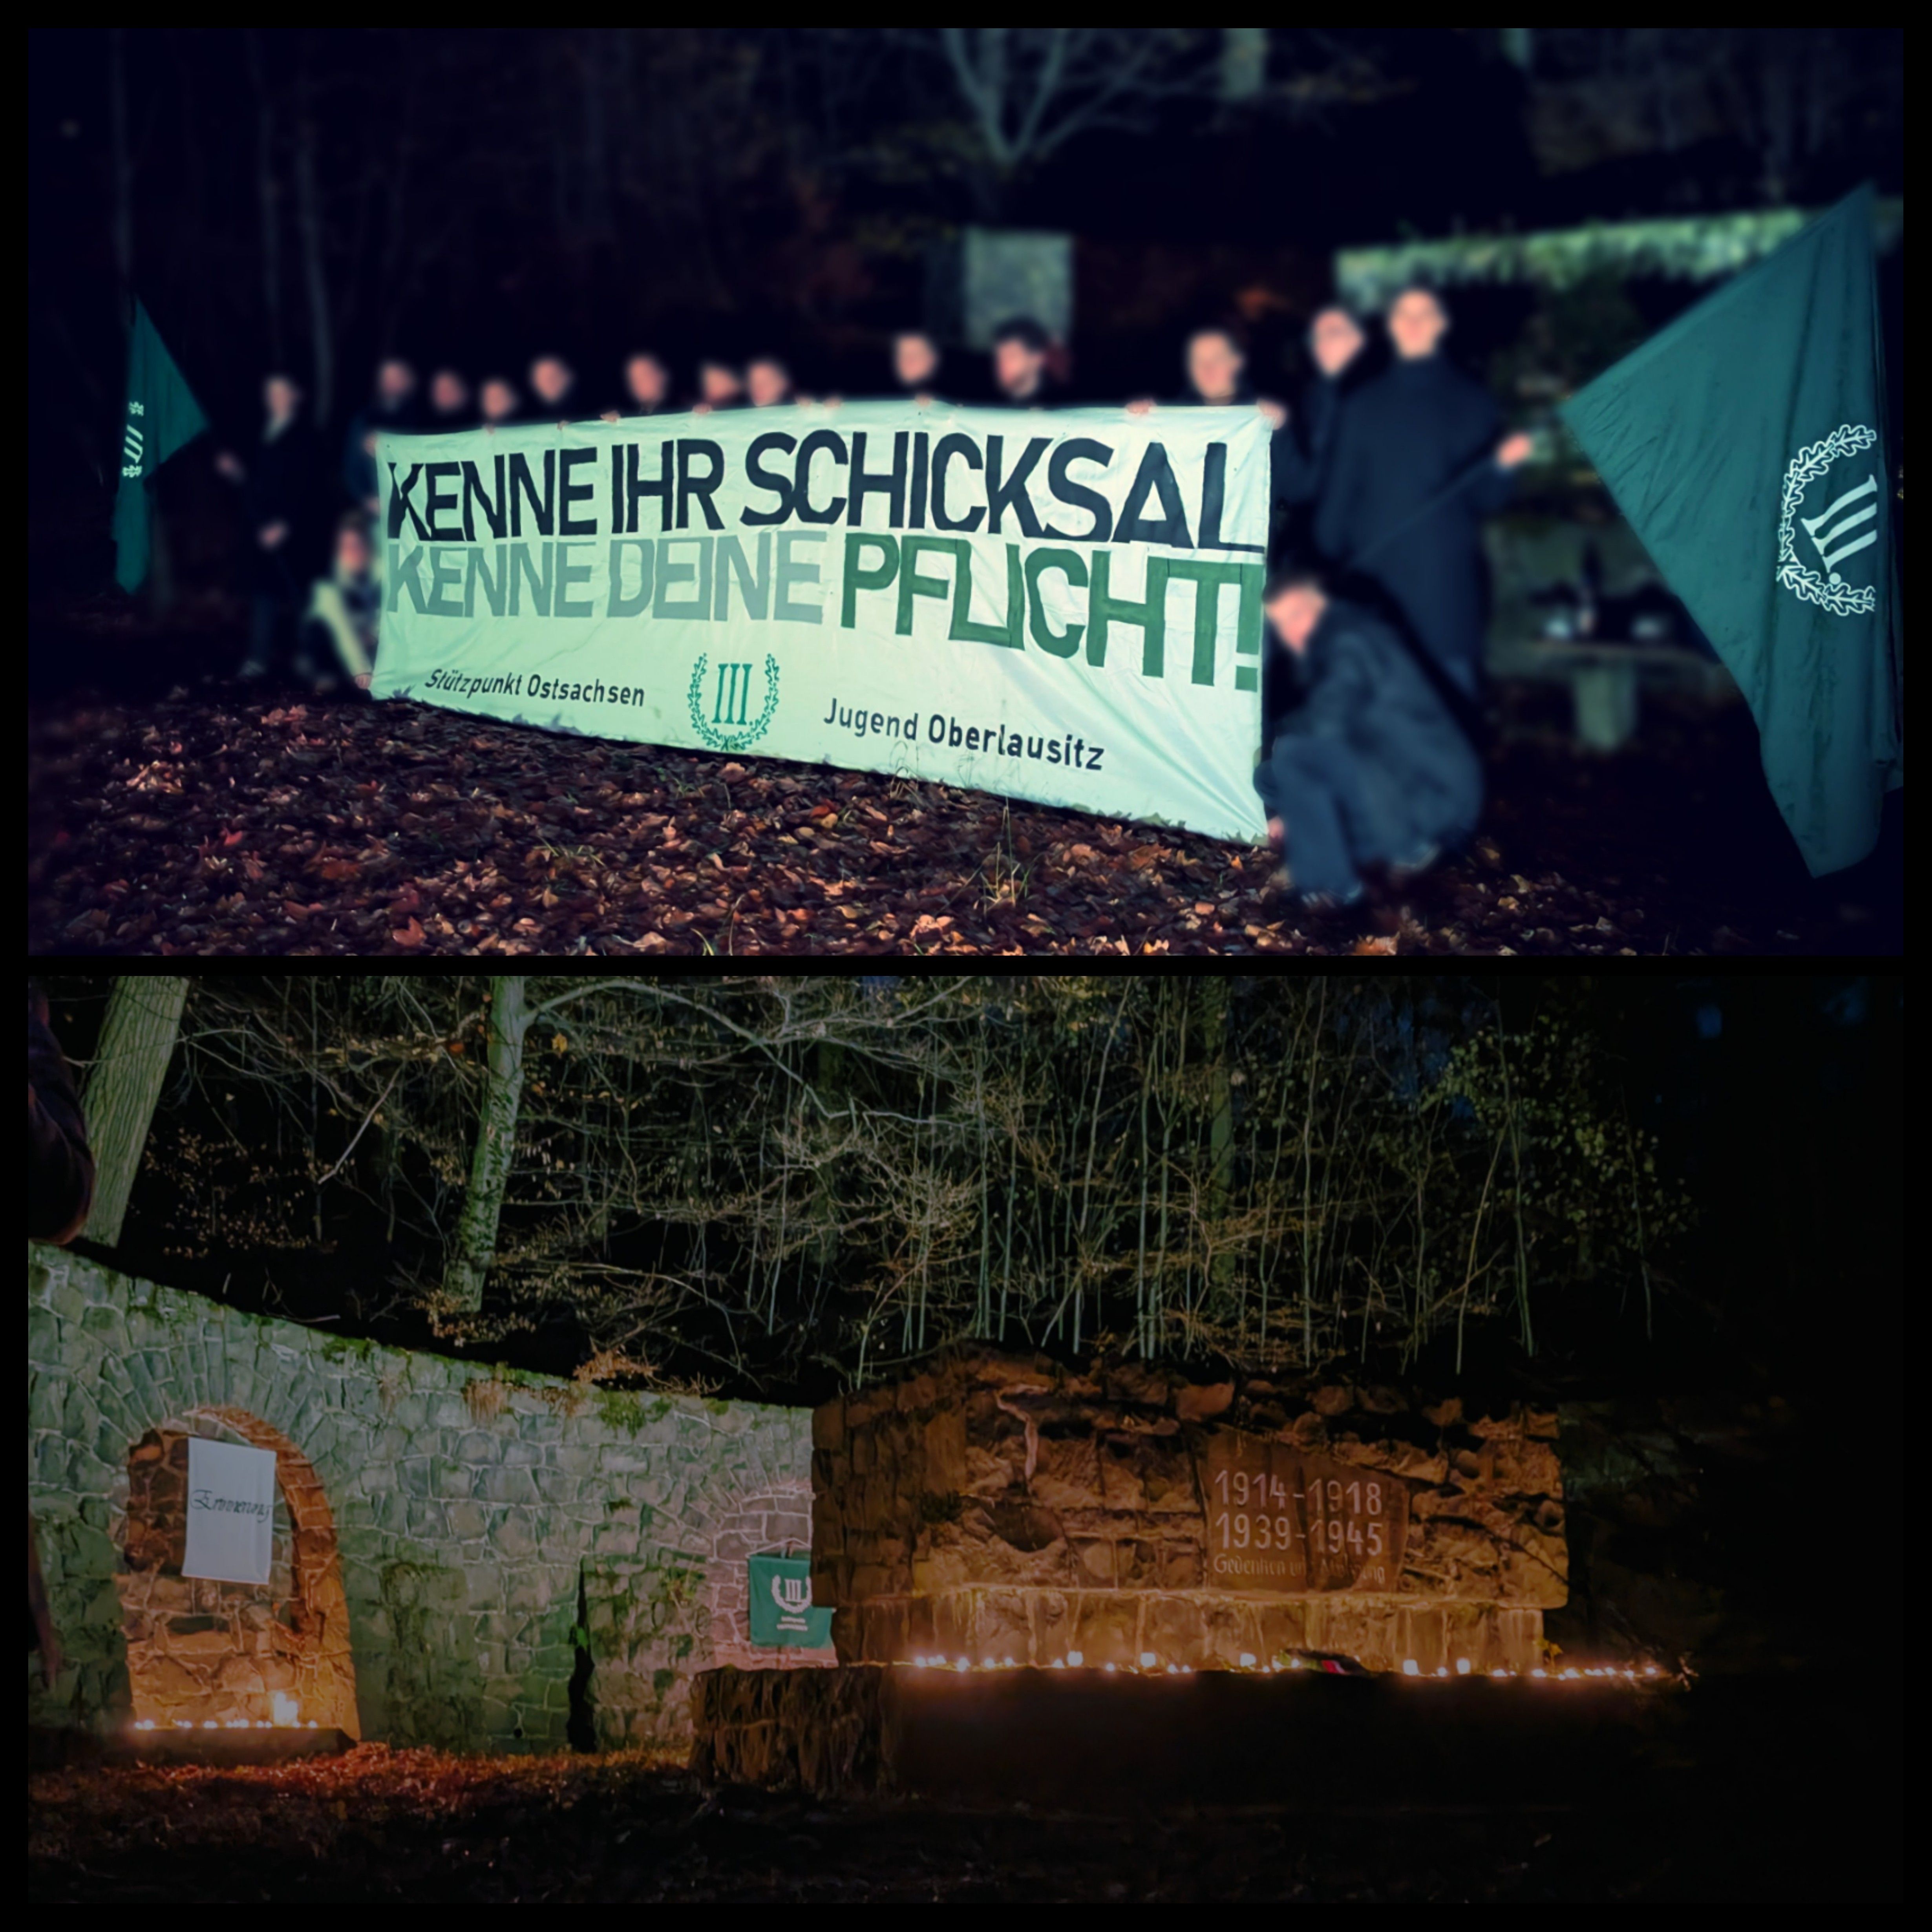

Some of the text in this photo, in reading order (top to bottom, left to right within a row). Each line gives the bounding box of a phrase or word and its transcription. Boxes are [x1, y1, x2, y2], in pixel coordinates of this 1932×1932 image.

[387, 429, 1265, 554] KENNE IHR SCHICKSAL
[387, 530, 1264, 693] KENNE DEINE PFLICHT!
[424, 668, 645, 707] Stützpunkt Ostsachsen
[823, 698, 1105, 771] Jugend Oberlausitz
